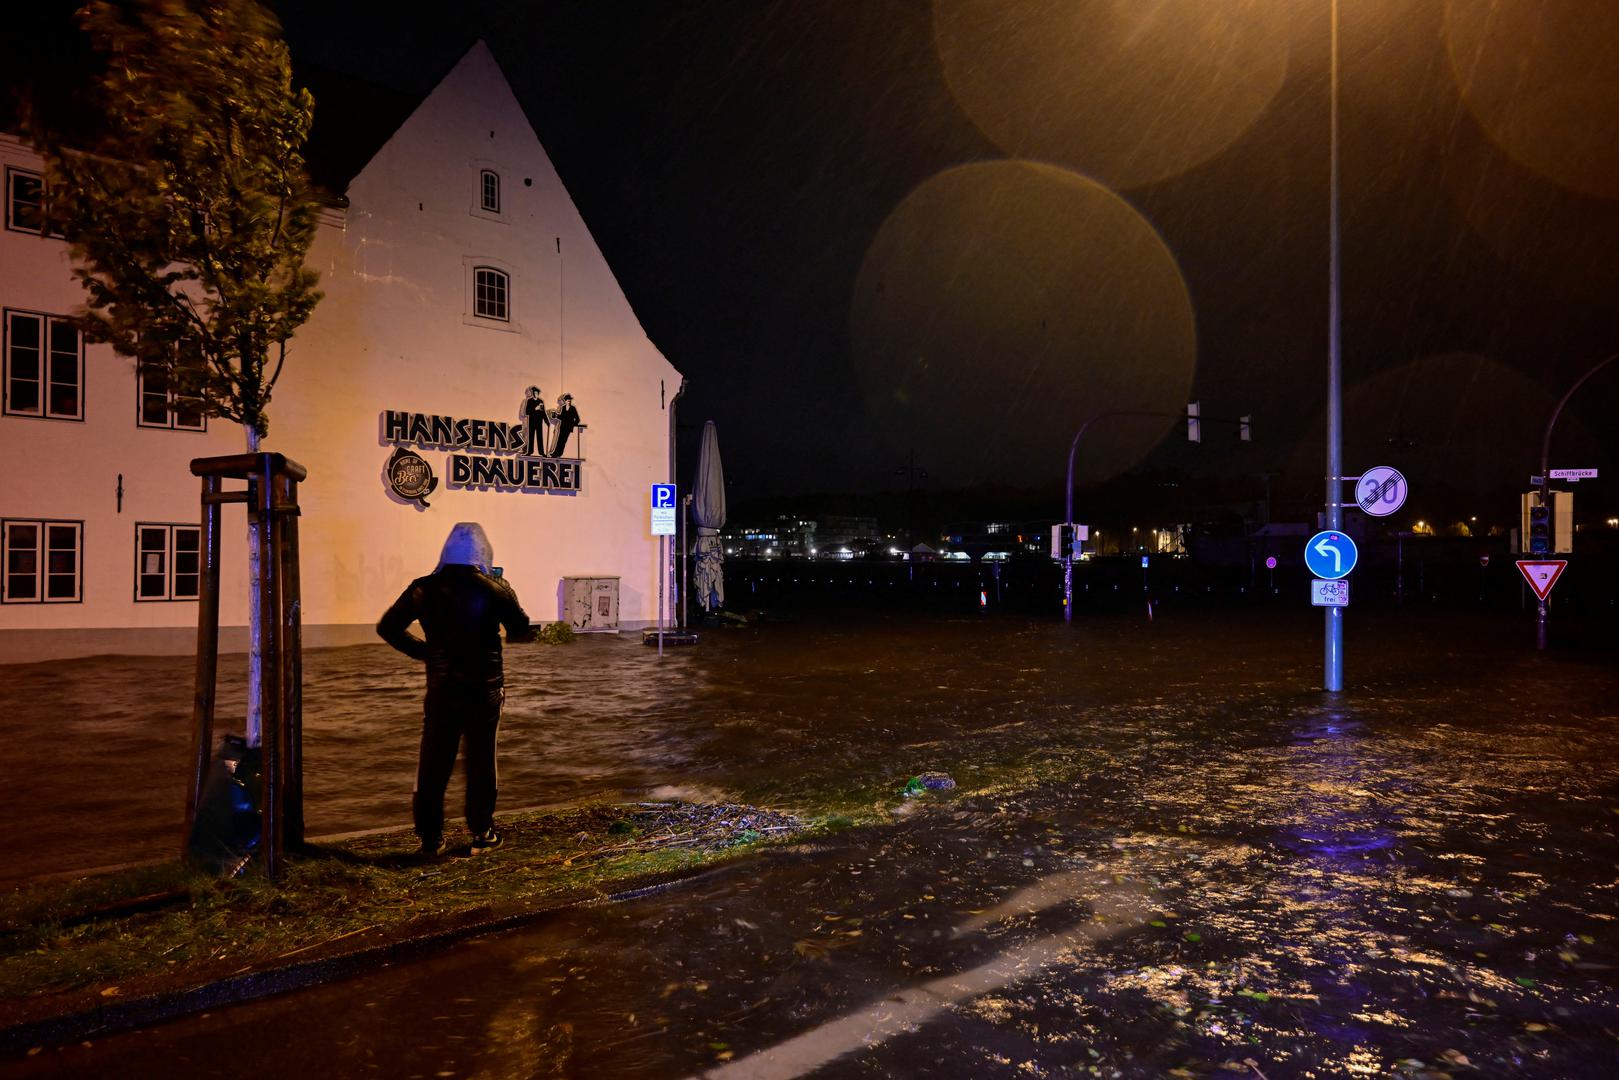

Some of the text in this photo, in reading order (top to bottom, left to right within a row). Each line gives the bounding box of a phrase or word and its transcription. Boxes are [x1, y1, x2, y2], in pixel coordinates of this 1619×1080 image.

[386, 410, 528, 452] HANSENS
[453, 455, 581, 489] BRAUEREI
[658, 488, 670, 507] P
[1365, 479, 1398, 504] 30
